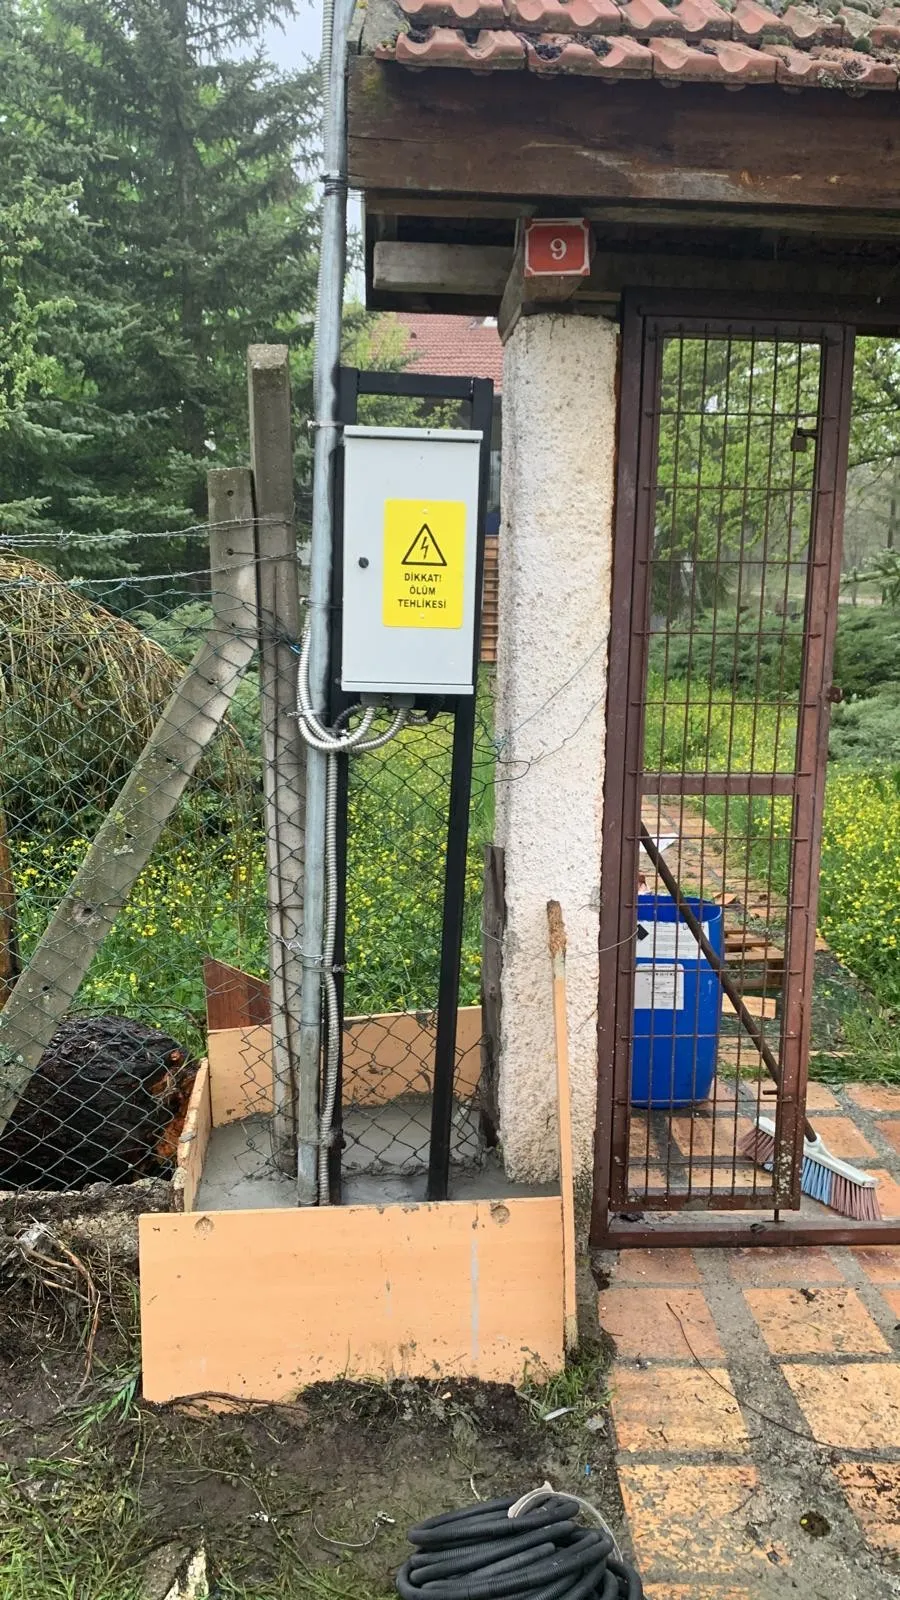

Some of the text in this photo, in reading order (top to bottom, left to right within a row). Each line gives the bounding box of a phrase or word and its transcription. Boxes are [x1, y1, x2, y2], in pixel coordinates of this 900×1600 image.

[550, 238, 567, 260] 9
[404, 571, 442, 582] DİKKAT!
[409, 584, 436, 595] ÖLÜM
[397, 598, 447, 609] TEHLİKESİ
